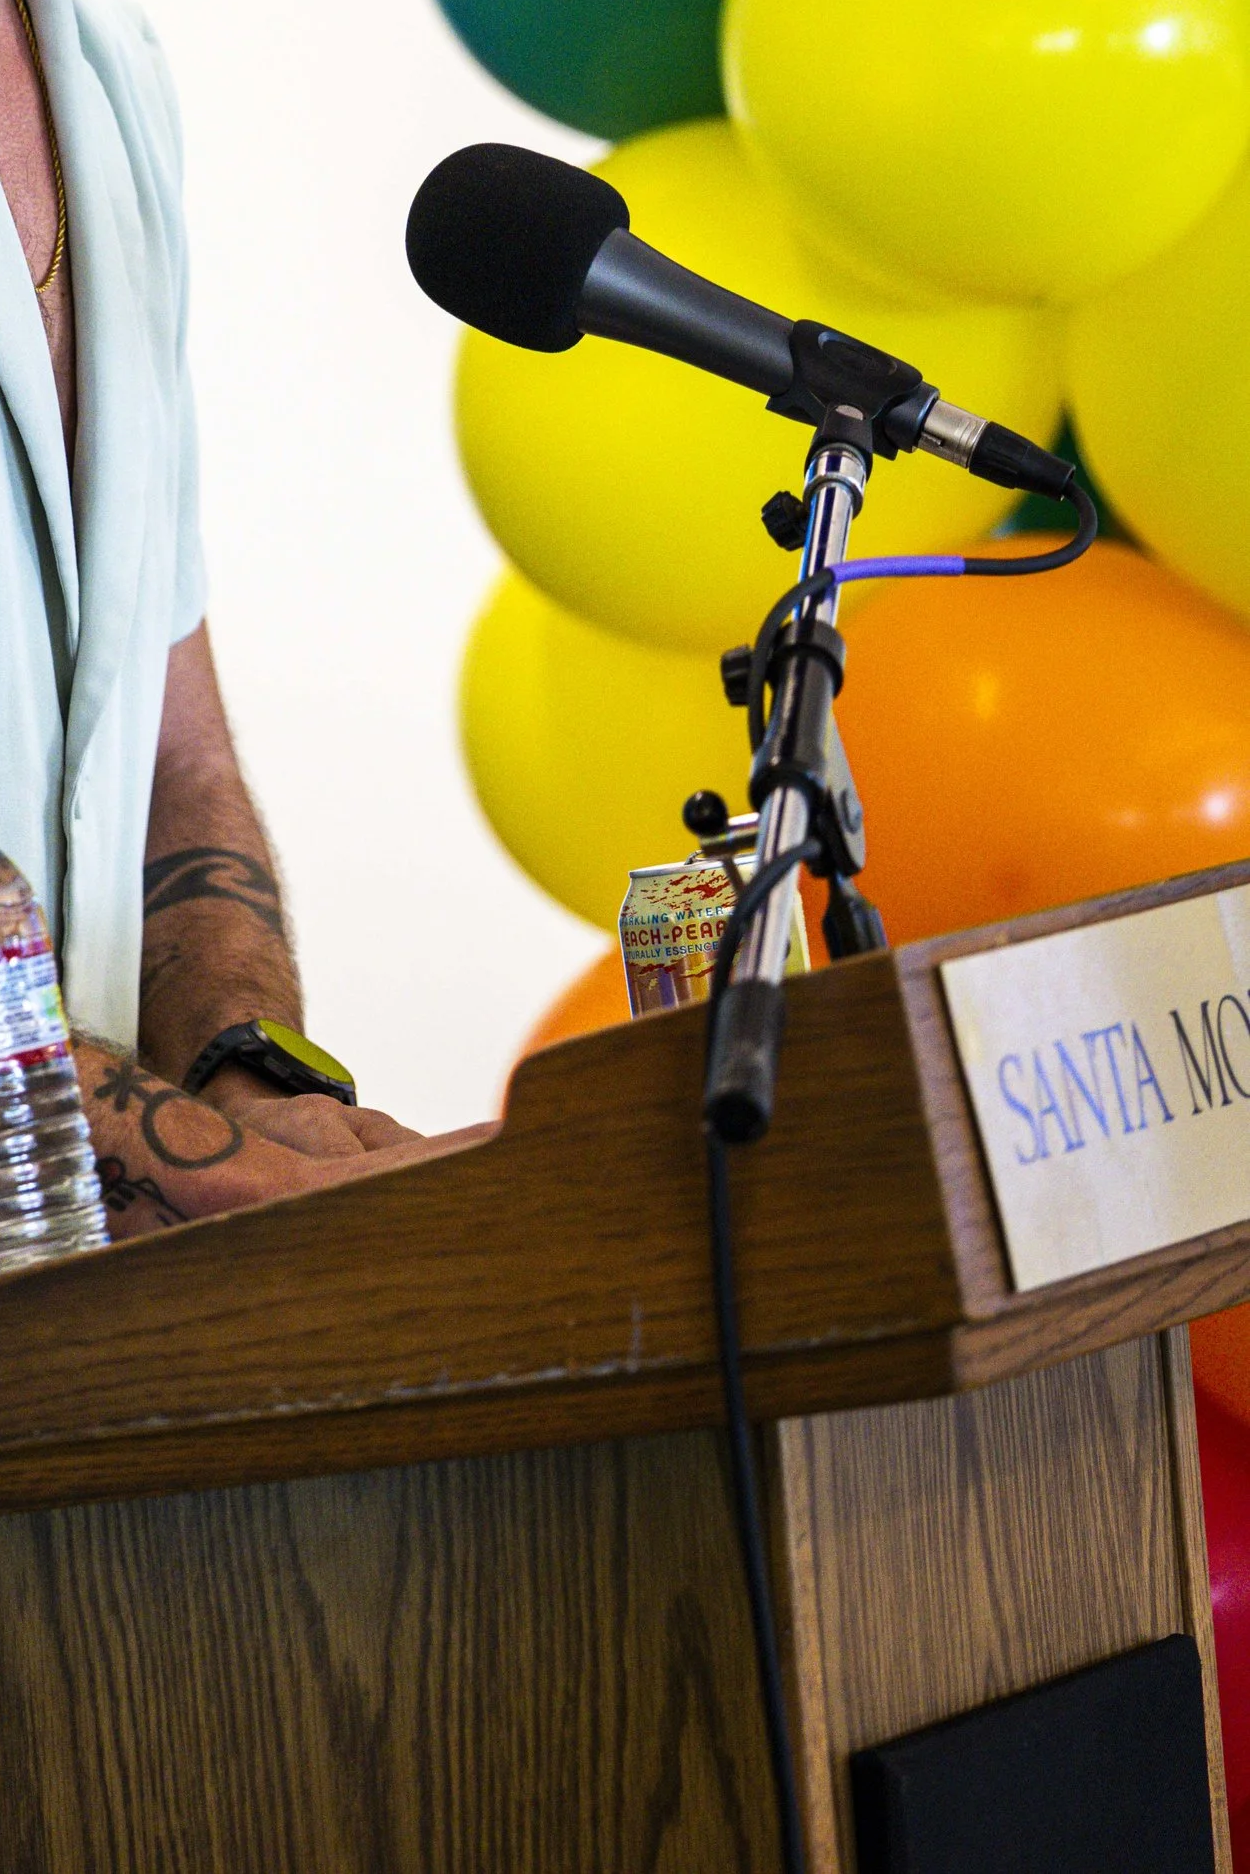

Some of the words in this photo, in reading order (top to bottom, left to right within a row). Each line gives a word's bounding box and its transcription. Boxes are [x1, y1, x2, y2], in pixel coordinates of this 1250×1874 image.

[675, 906, 724, 921] WATER
[624, 920, 726, 947] EACH-PEAR
[665, 941, 719, 957] ESSENCE
[997, 1021, 1175, 1166] SANTA
[1169, 990, 1250, 1116] MO
